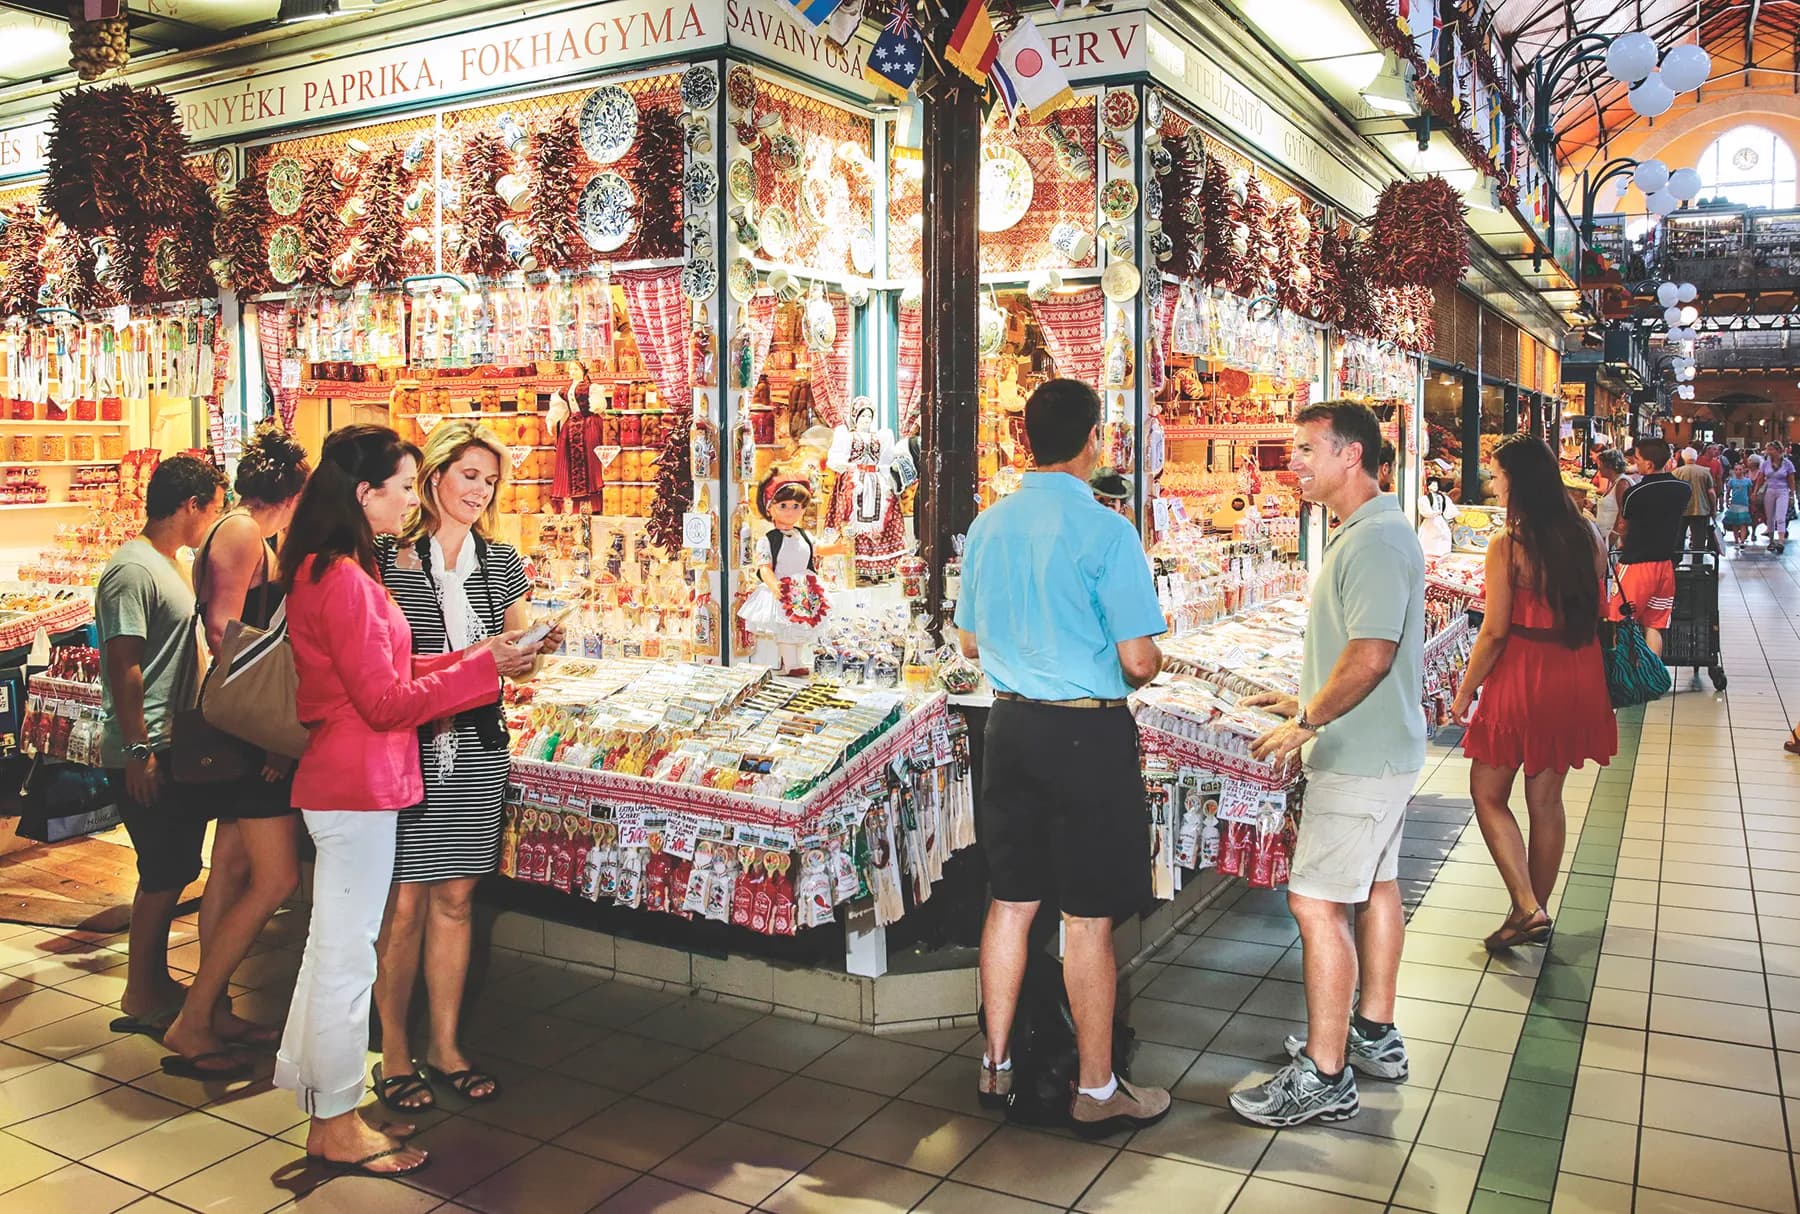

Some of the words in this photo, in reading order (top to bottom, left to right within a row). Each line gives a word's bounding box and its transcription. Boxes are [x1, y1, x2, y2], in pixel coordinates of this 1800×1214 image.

[0, 132, 21, 165] ÉS
[177, 82, 286, 132] RNYÉKI
[303, 57, 443, 112] PAPRIKA,
[460, 2, 706, 82] FOKHAGYMA
